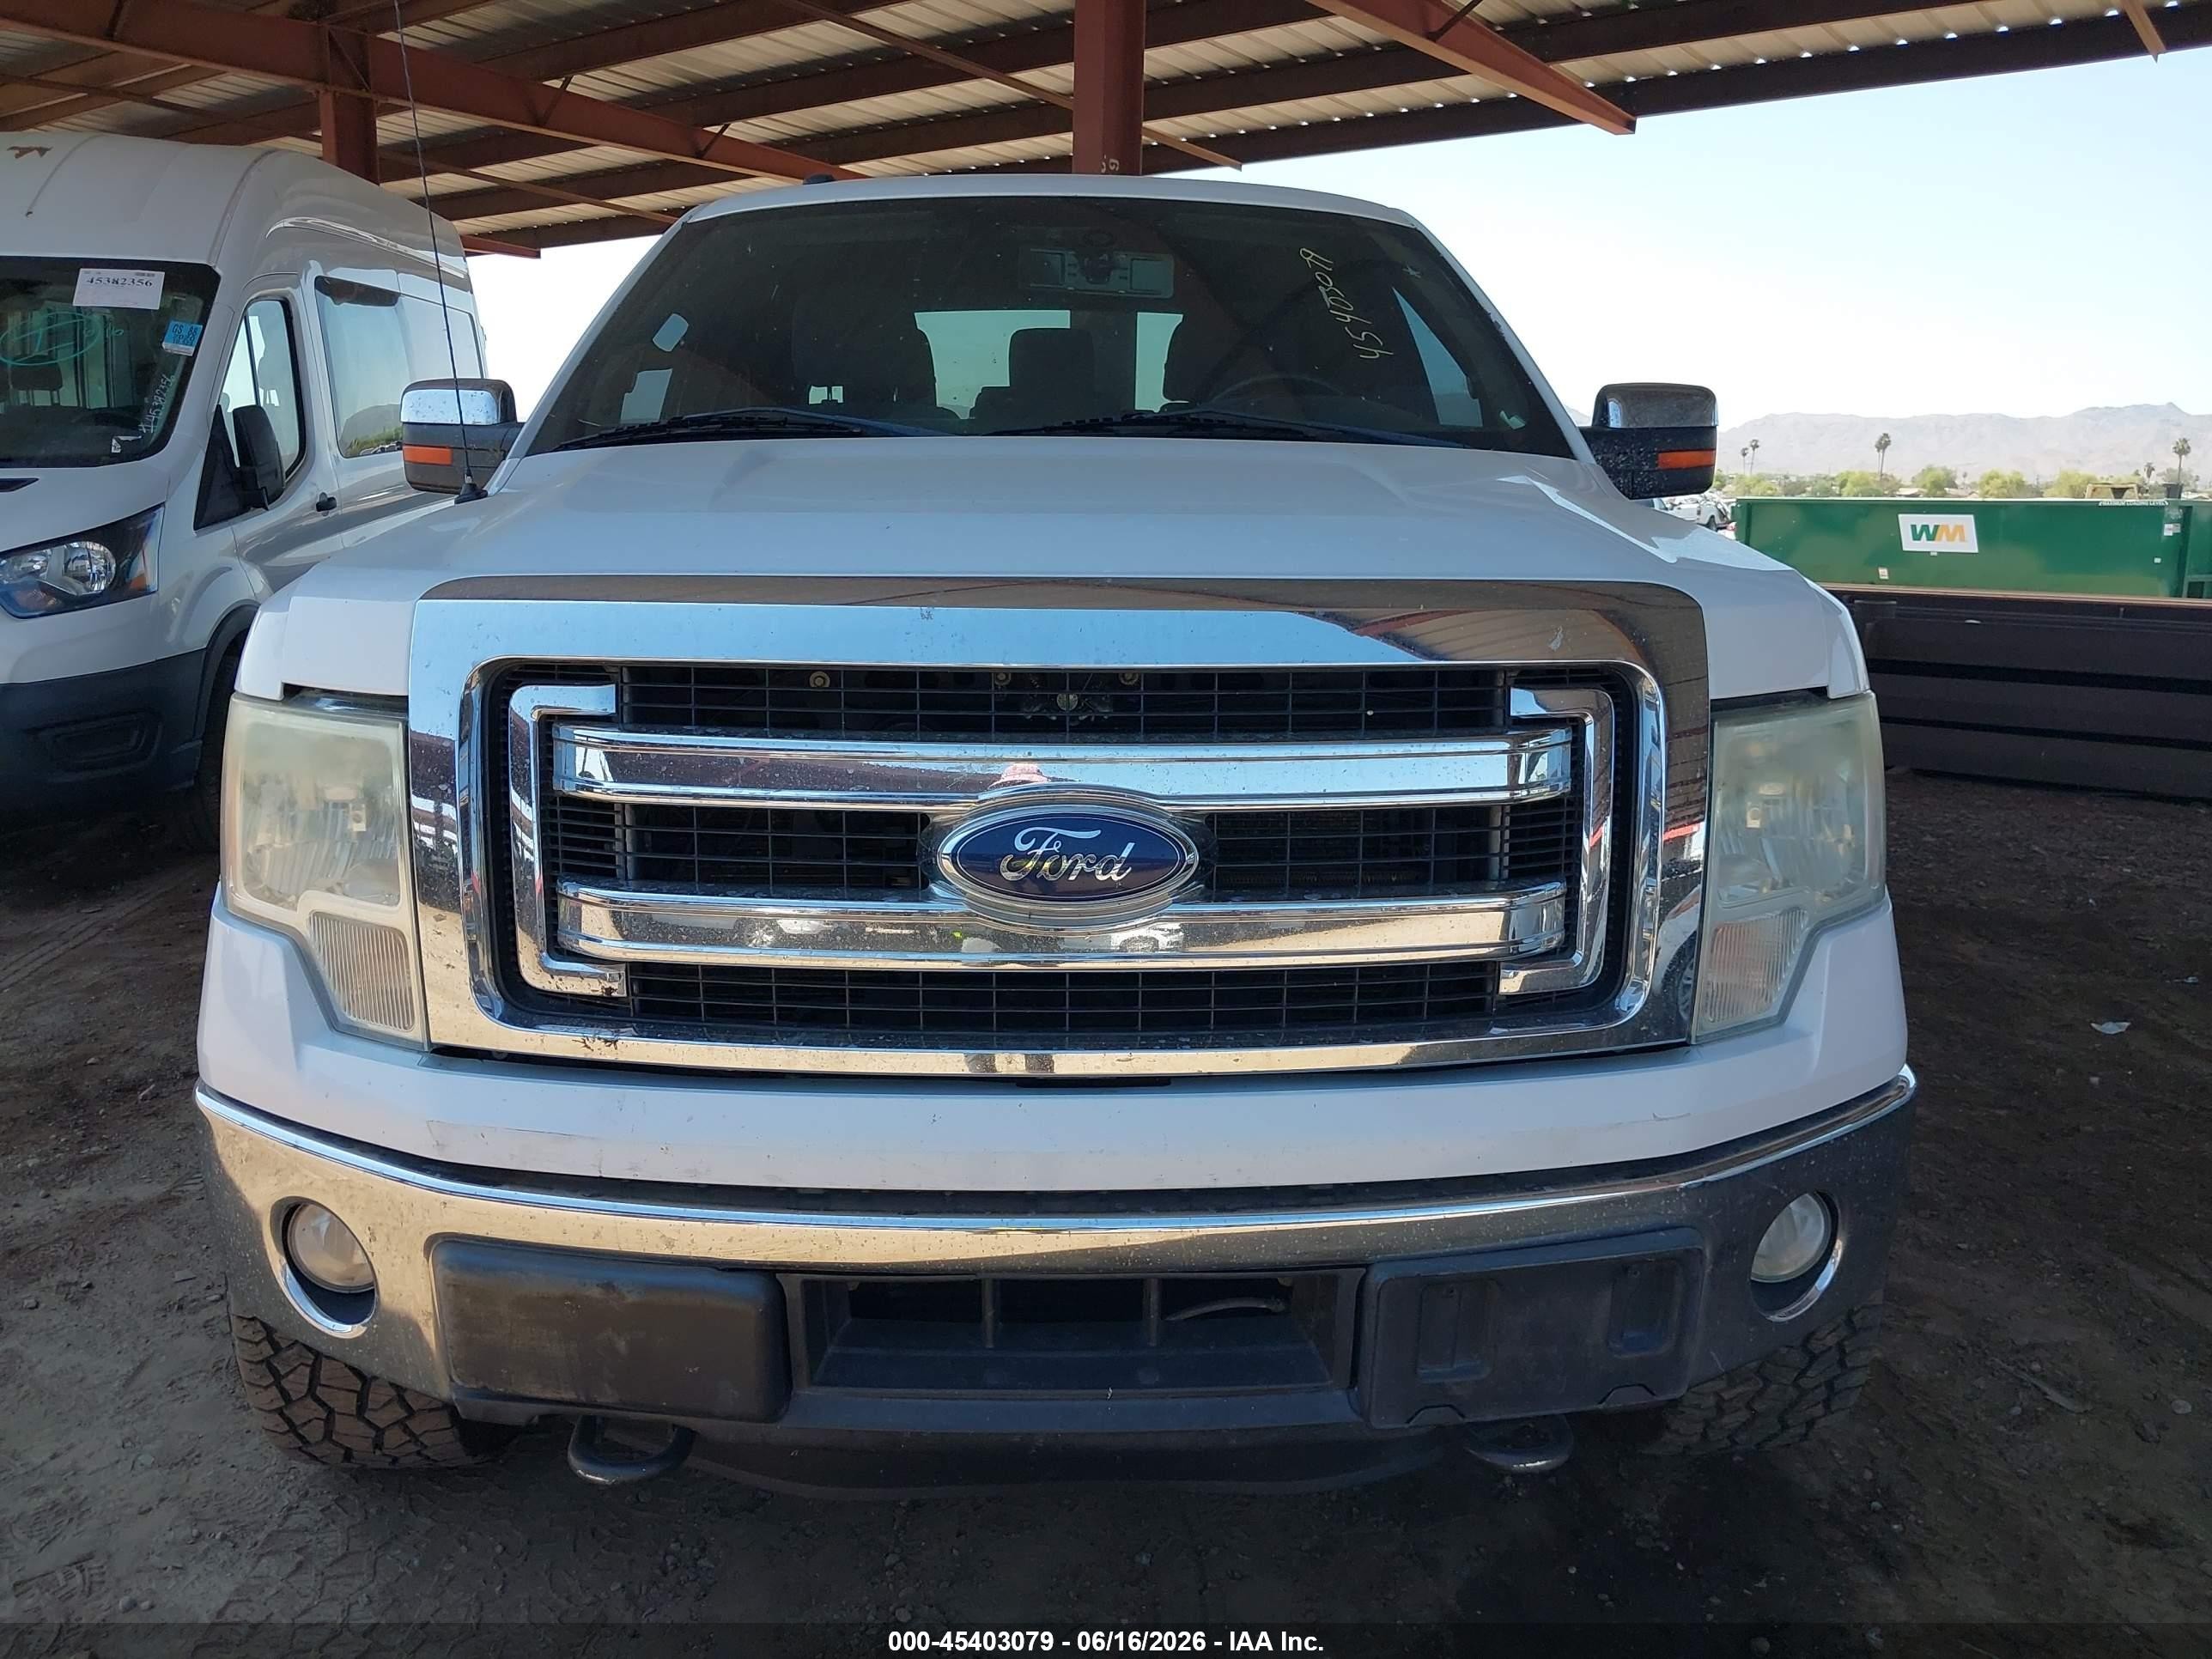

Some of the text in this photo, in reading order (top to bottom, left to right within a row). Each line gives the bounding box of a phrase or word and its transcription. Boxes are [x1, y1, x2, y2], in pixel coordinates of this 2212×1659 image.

[87, 276, 153, 287] 45382356
[1299, 247, 1394, 359] 45403079
[1910, 523, 1966, 543] WM
[1000, 826, 1136, 882] Ford
